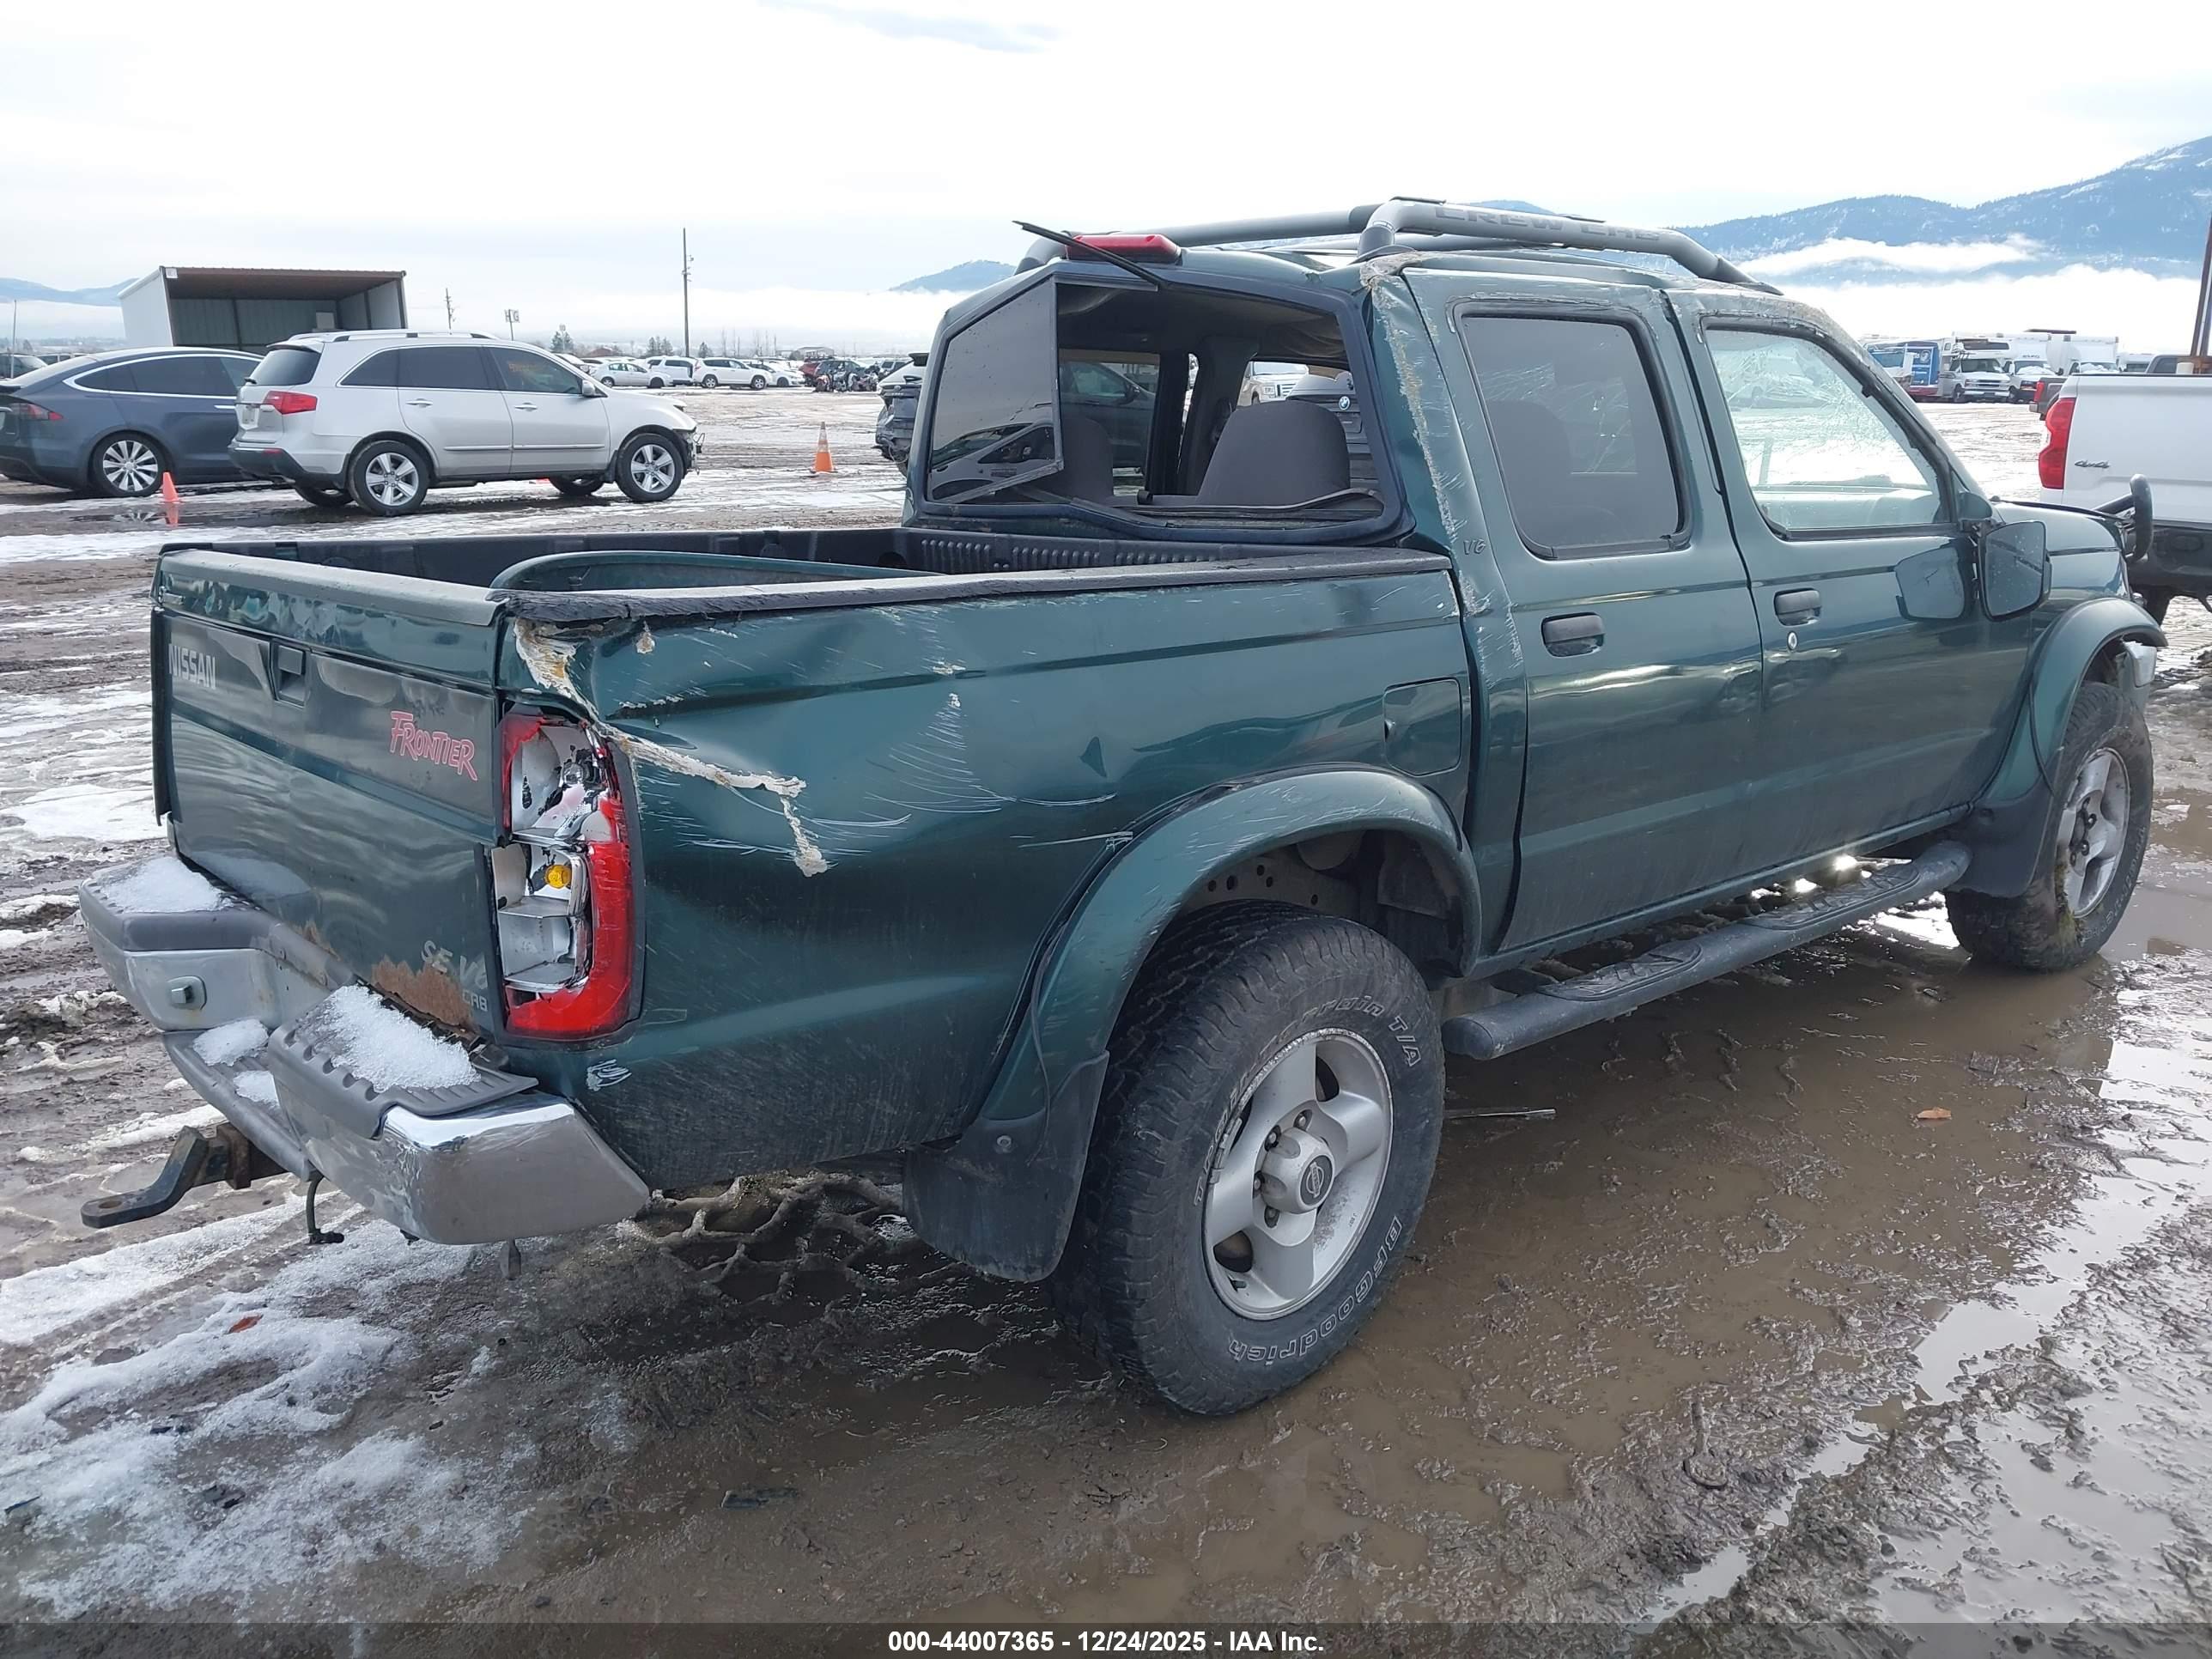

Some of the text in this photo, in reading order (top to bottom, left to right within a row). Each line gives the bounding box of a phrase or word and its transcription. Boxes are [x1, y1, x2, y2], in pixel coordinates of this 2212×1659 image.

[1435, 206, 1564, 230] CREW
[1462, 538, 1486, 555] V6
[168, 643, 216, 690] NISSAN
[390, 711, 478, 781] FRONTIER
[462, 989, 488, 1012] CAB
[1229, 1215, 1402, 1365] BFGoodrich
